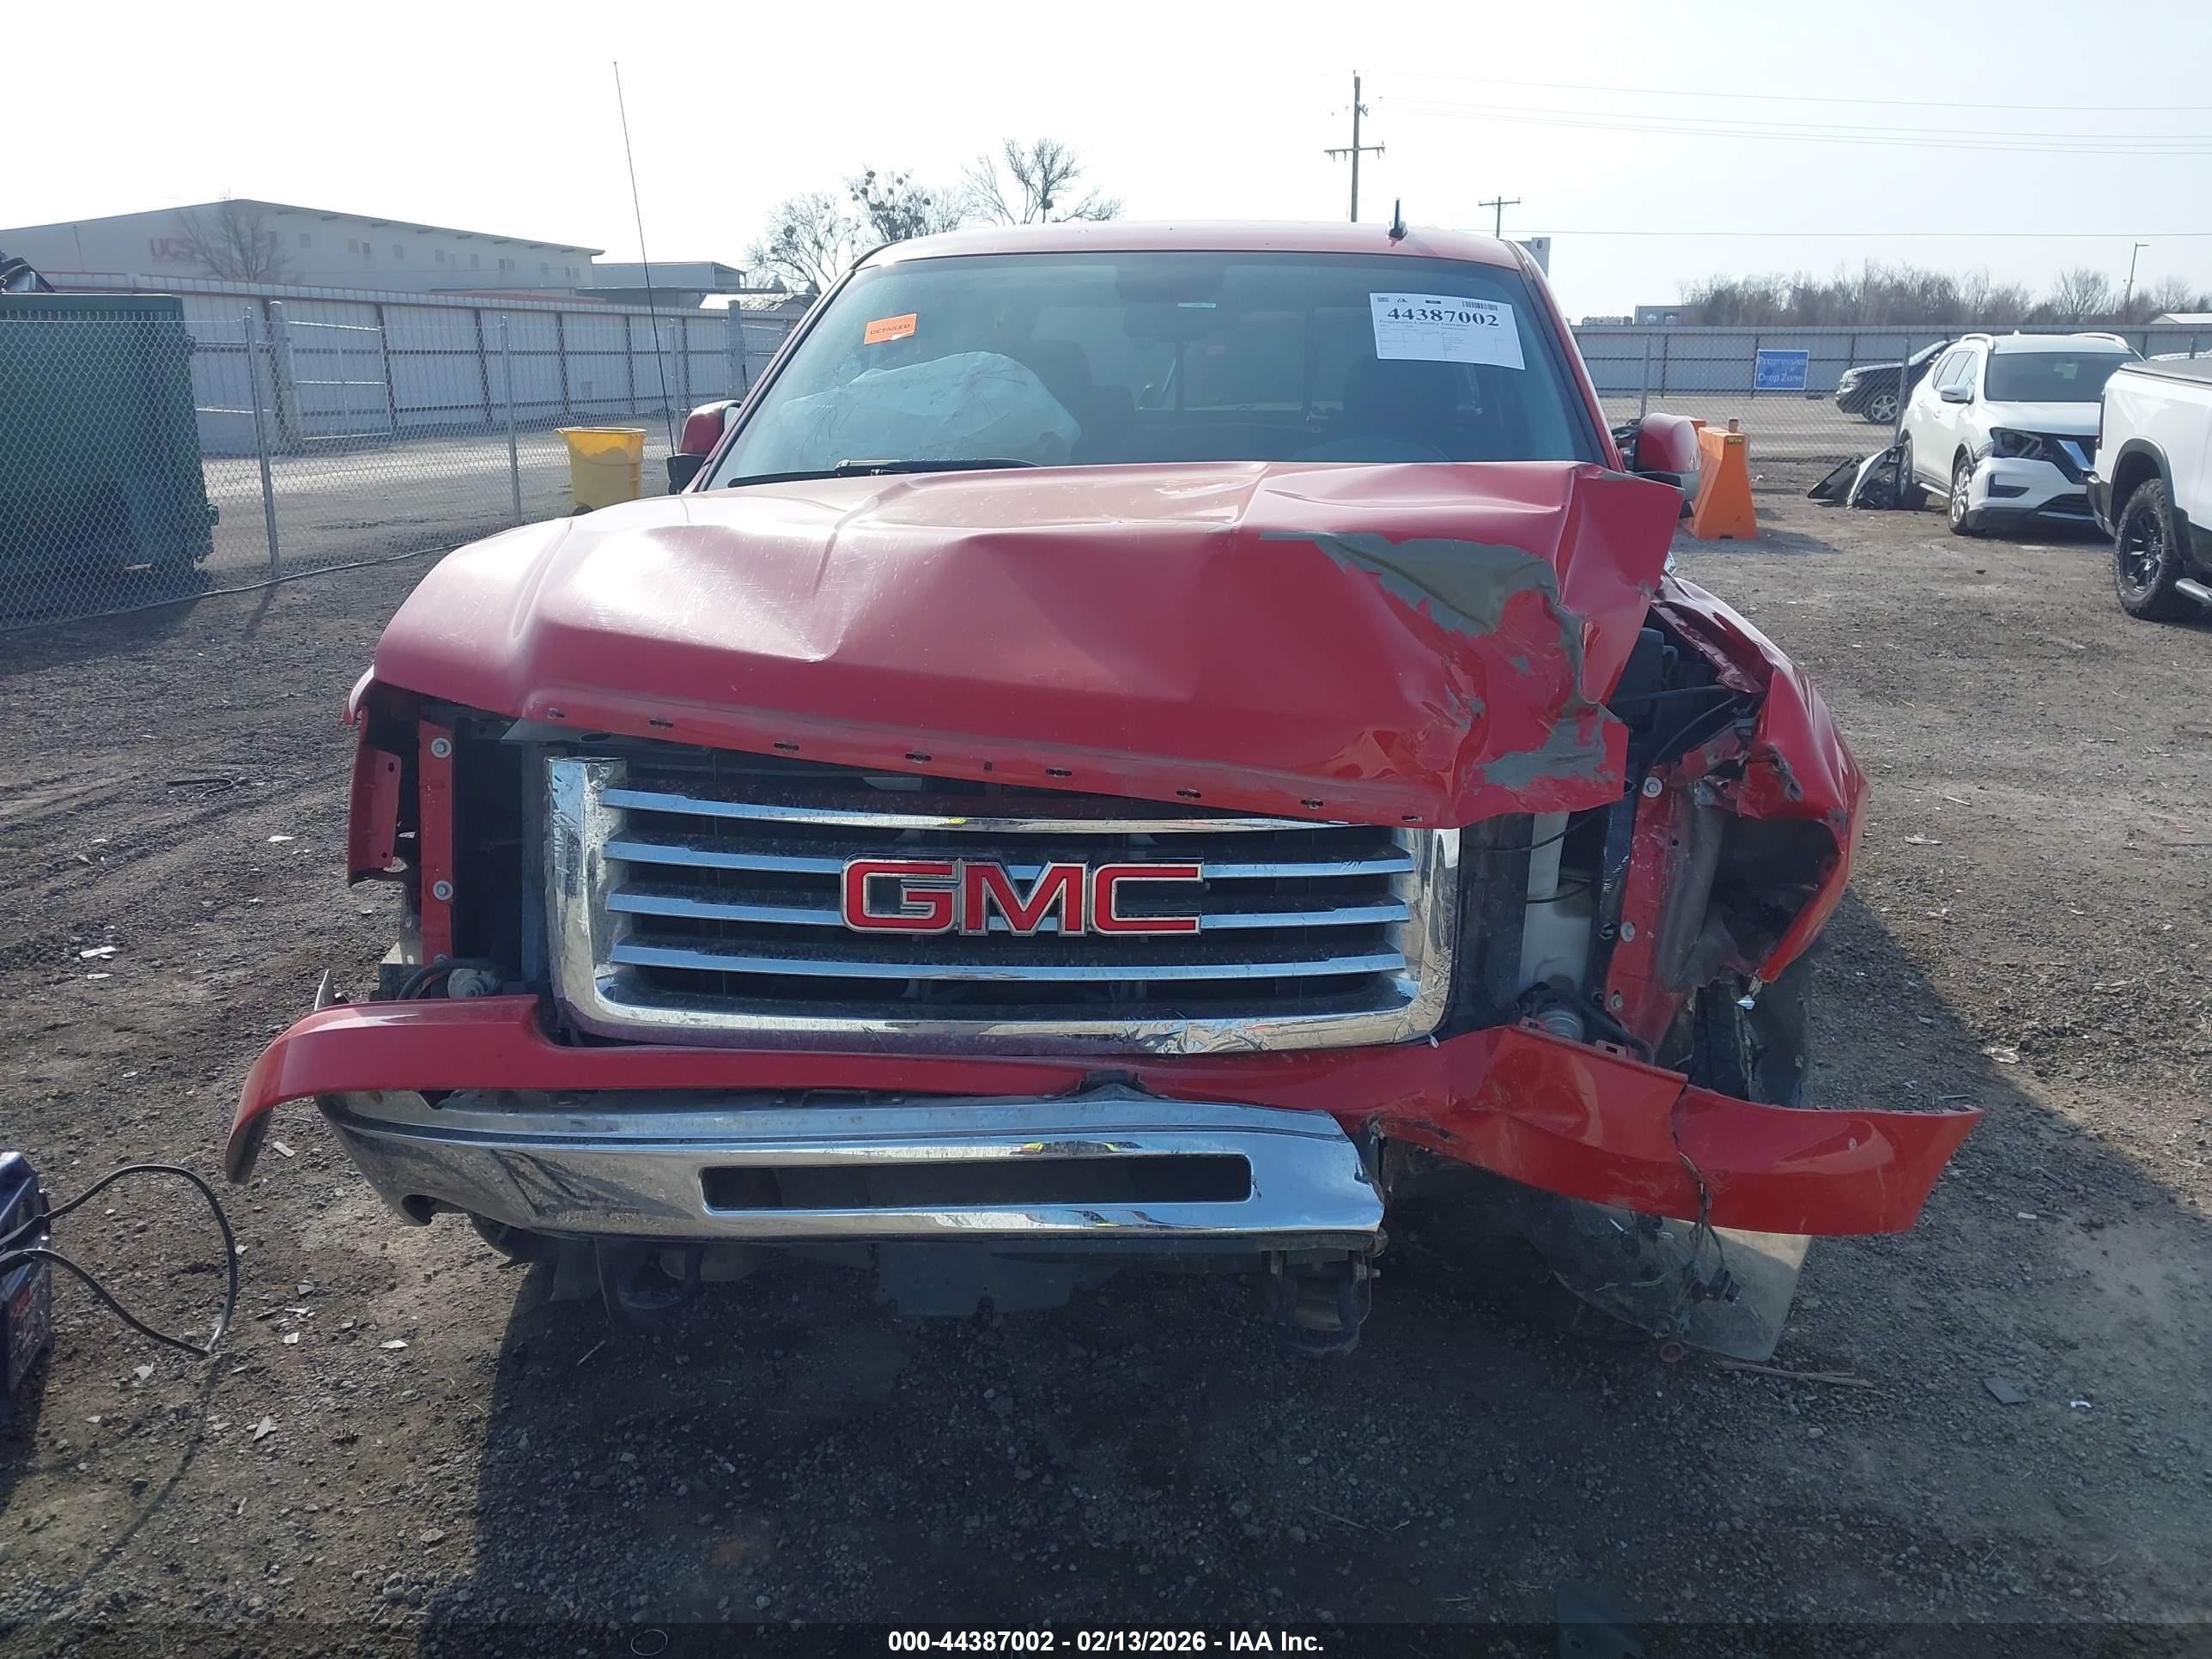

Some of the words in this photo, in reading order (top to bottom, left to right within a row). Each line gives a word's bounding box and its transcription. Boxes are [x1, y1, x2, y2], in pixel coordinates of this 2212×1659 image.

[1387, 307, 1499, 326] 44387002
[870, 324, 910, 335] DETAILED
[1758, 373, 1780, 383] Drop
[1780, 372, 1803, 382] Zone
[840, 853, 1205, 937] GMC
